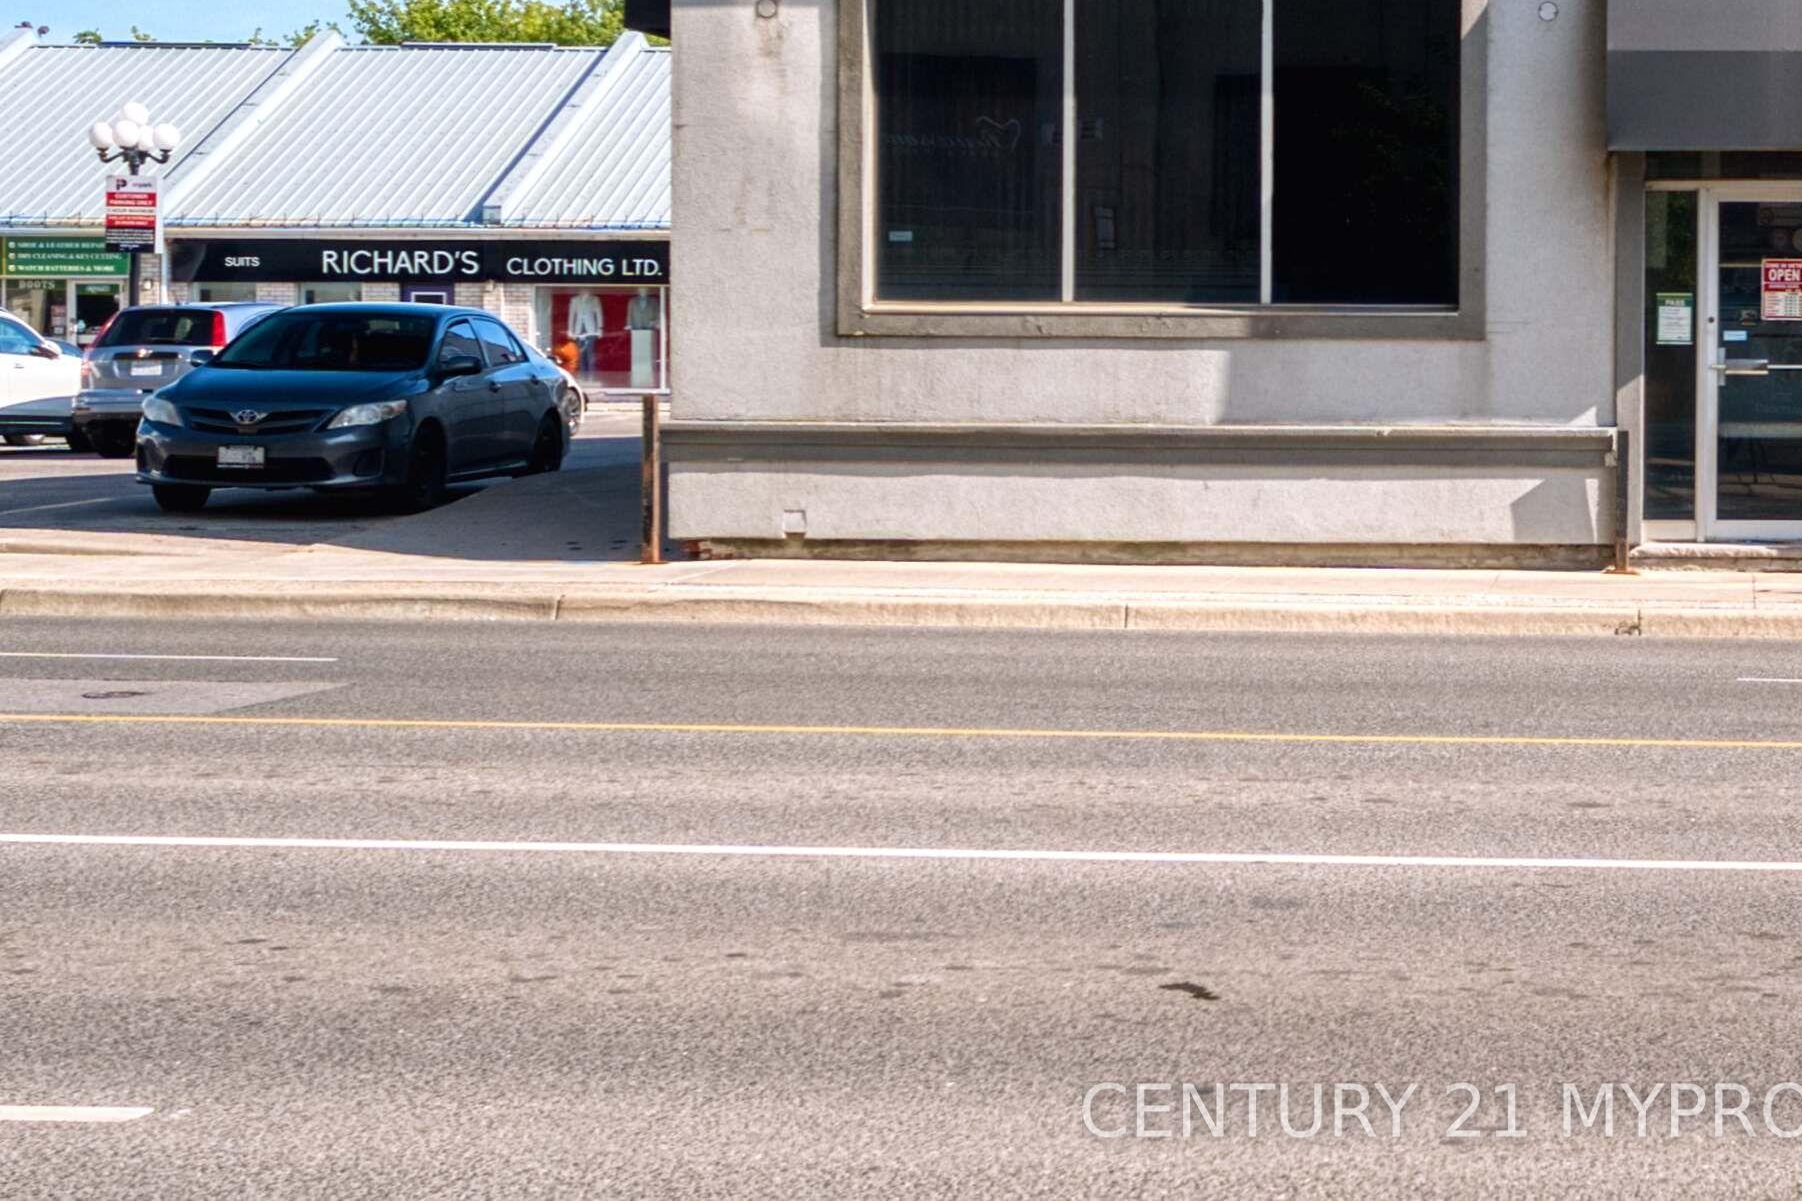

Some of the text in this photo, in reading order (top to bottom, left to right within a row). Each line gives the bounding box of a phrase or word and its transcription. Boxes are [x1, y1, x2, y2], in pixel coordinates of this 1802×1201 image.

[224, 255, 261, 267] SUITS
[321, 250, 663, 276] RICHARD'S CLOTHING LTD.
[1768, 268, 1801, 282] OPEN
